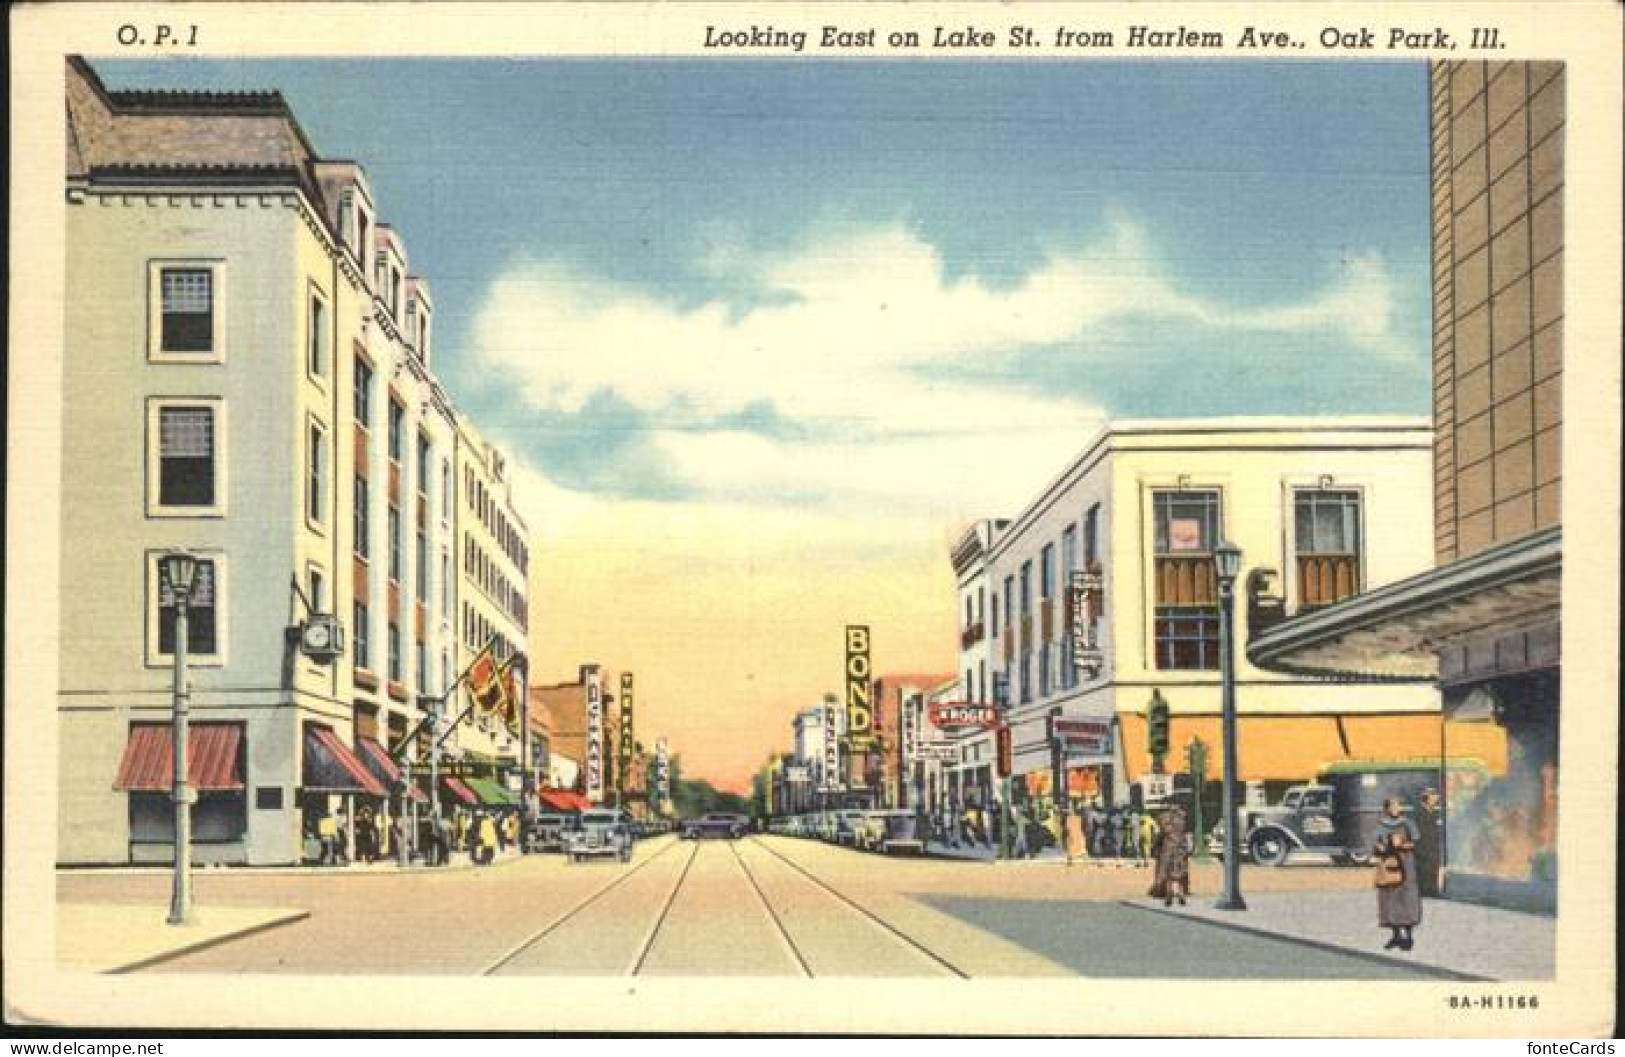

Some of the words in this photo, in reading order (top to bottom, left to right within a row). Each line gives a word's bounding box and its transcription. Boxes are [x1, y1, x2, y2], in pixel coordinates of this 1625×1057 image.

[117, 24, 145, 46] O.
[153, 25, 178, 46] P.
[703, 26, 807, 52] Looking
[820, 26, 876, 48] East
[887, 32, 919, 48] on
[933, 27, 996, 48] Lake
[1008, 26, 1040, 48] St.
[1054, 27, 1114, 48] from
[1127, 26, 1224, 48] Harlem
[1236, 27, 1306, 49] Ave.,
[1319, 27, 1375, 49] Oak
[1387, 28, 1457, 50] Park,
[1469, 28, 1506, 50] Ill.
[848, 628, 871, 732] BOND
[1449, 995, 1539, 1010] 8A-H1166
